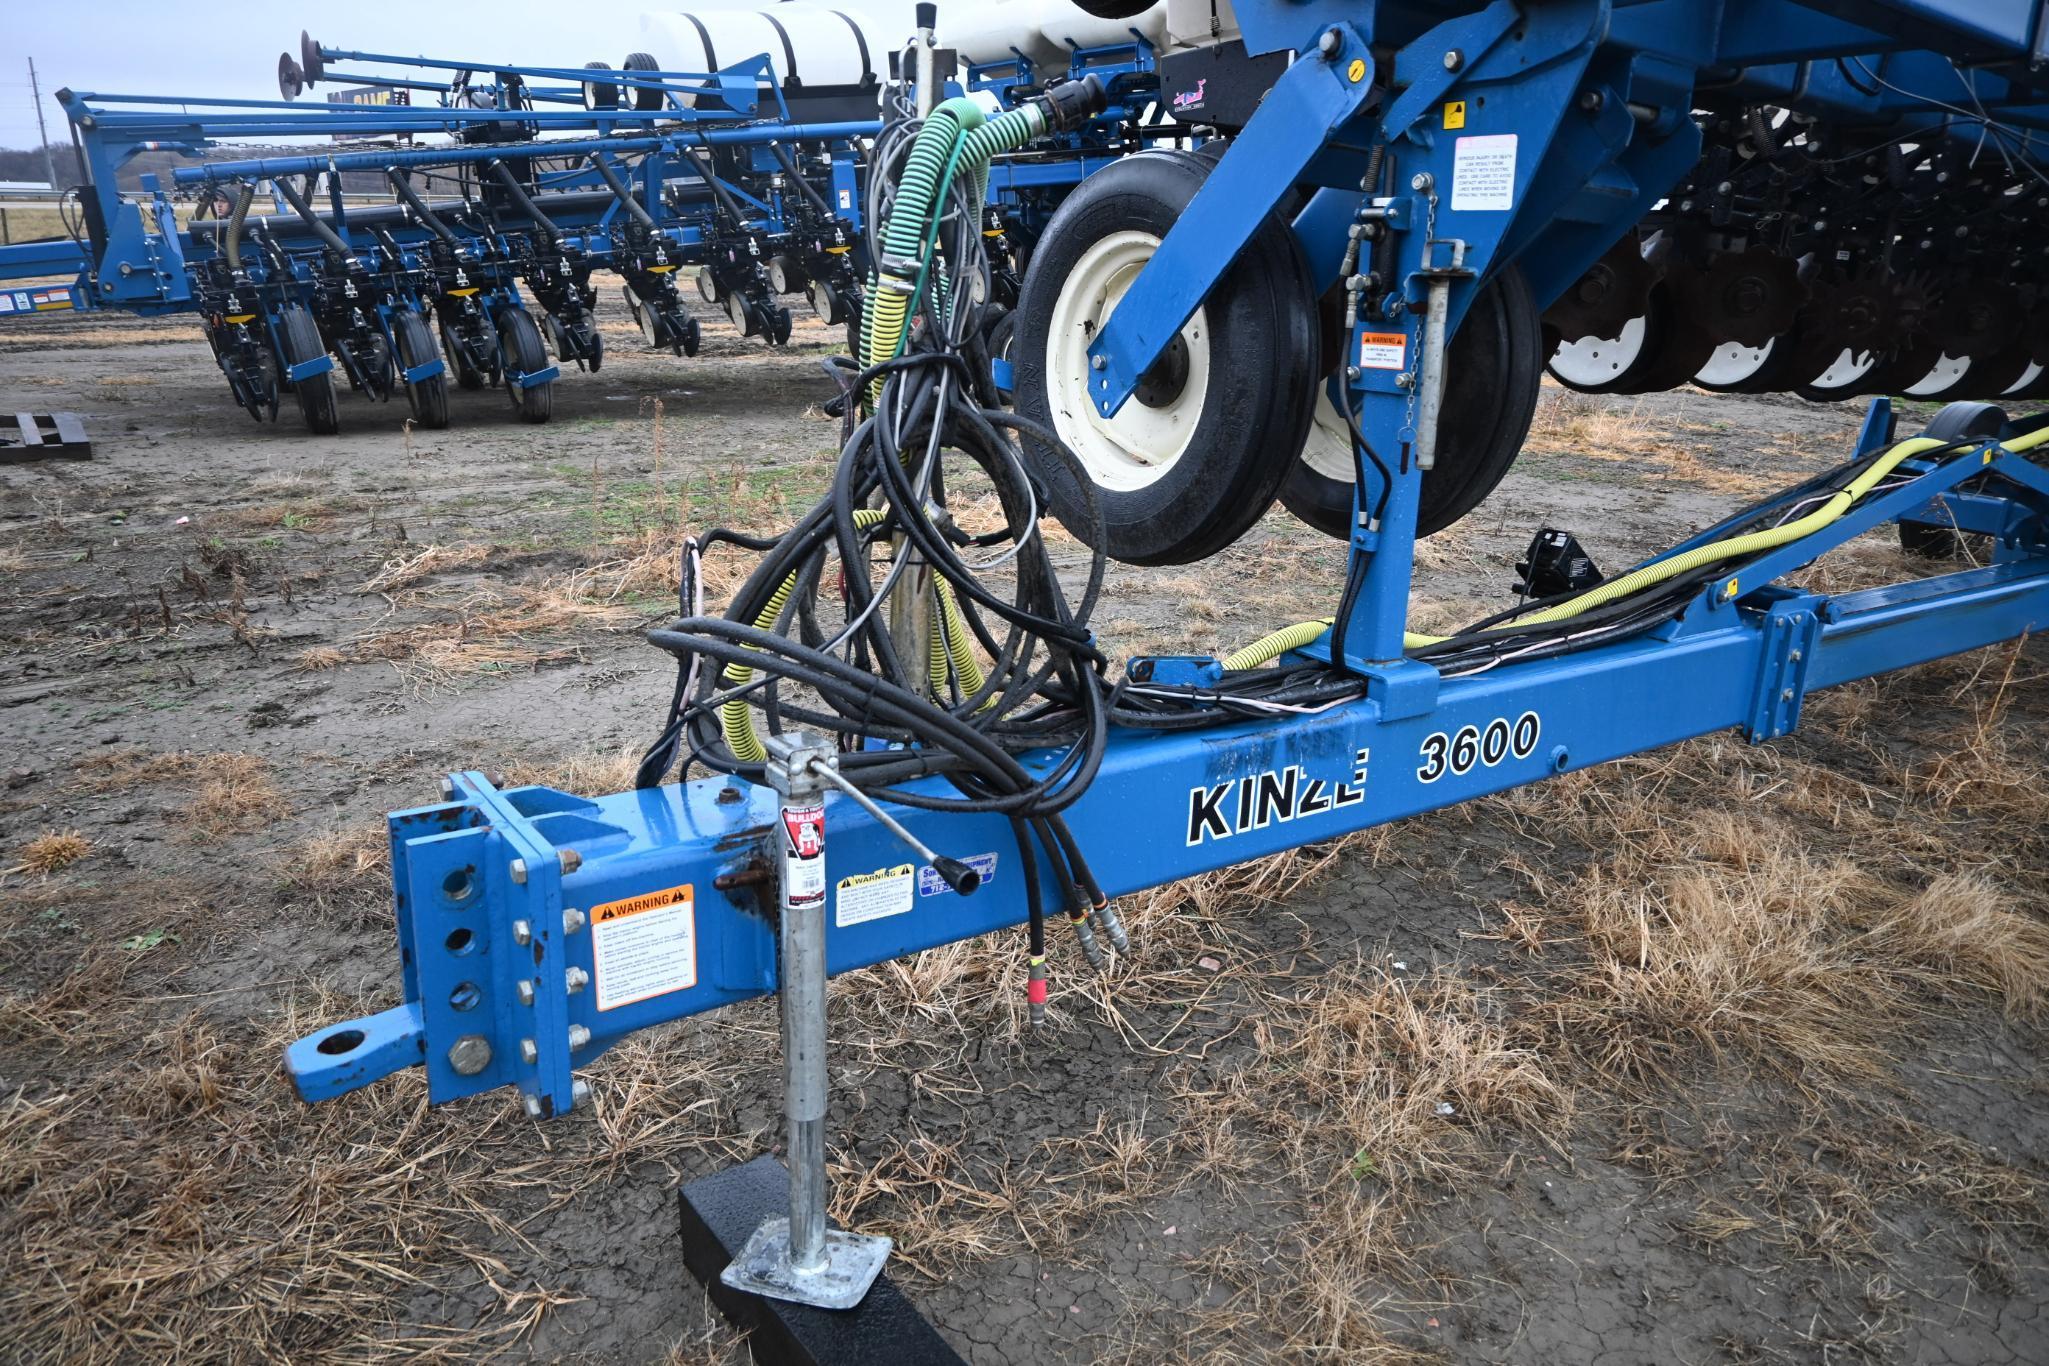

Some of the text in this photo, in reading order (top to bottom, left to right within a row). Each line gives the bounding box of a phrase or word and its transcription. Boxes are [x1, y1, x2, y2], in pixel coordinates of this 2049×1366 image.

[1371, 336, 1396, 345] WARNING
[1416, 710, 1541, 784] 3600
[854, 870, 897, 885] WARNING
[616, 894, 670, 916] WARNING
